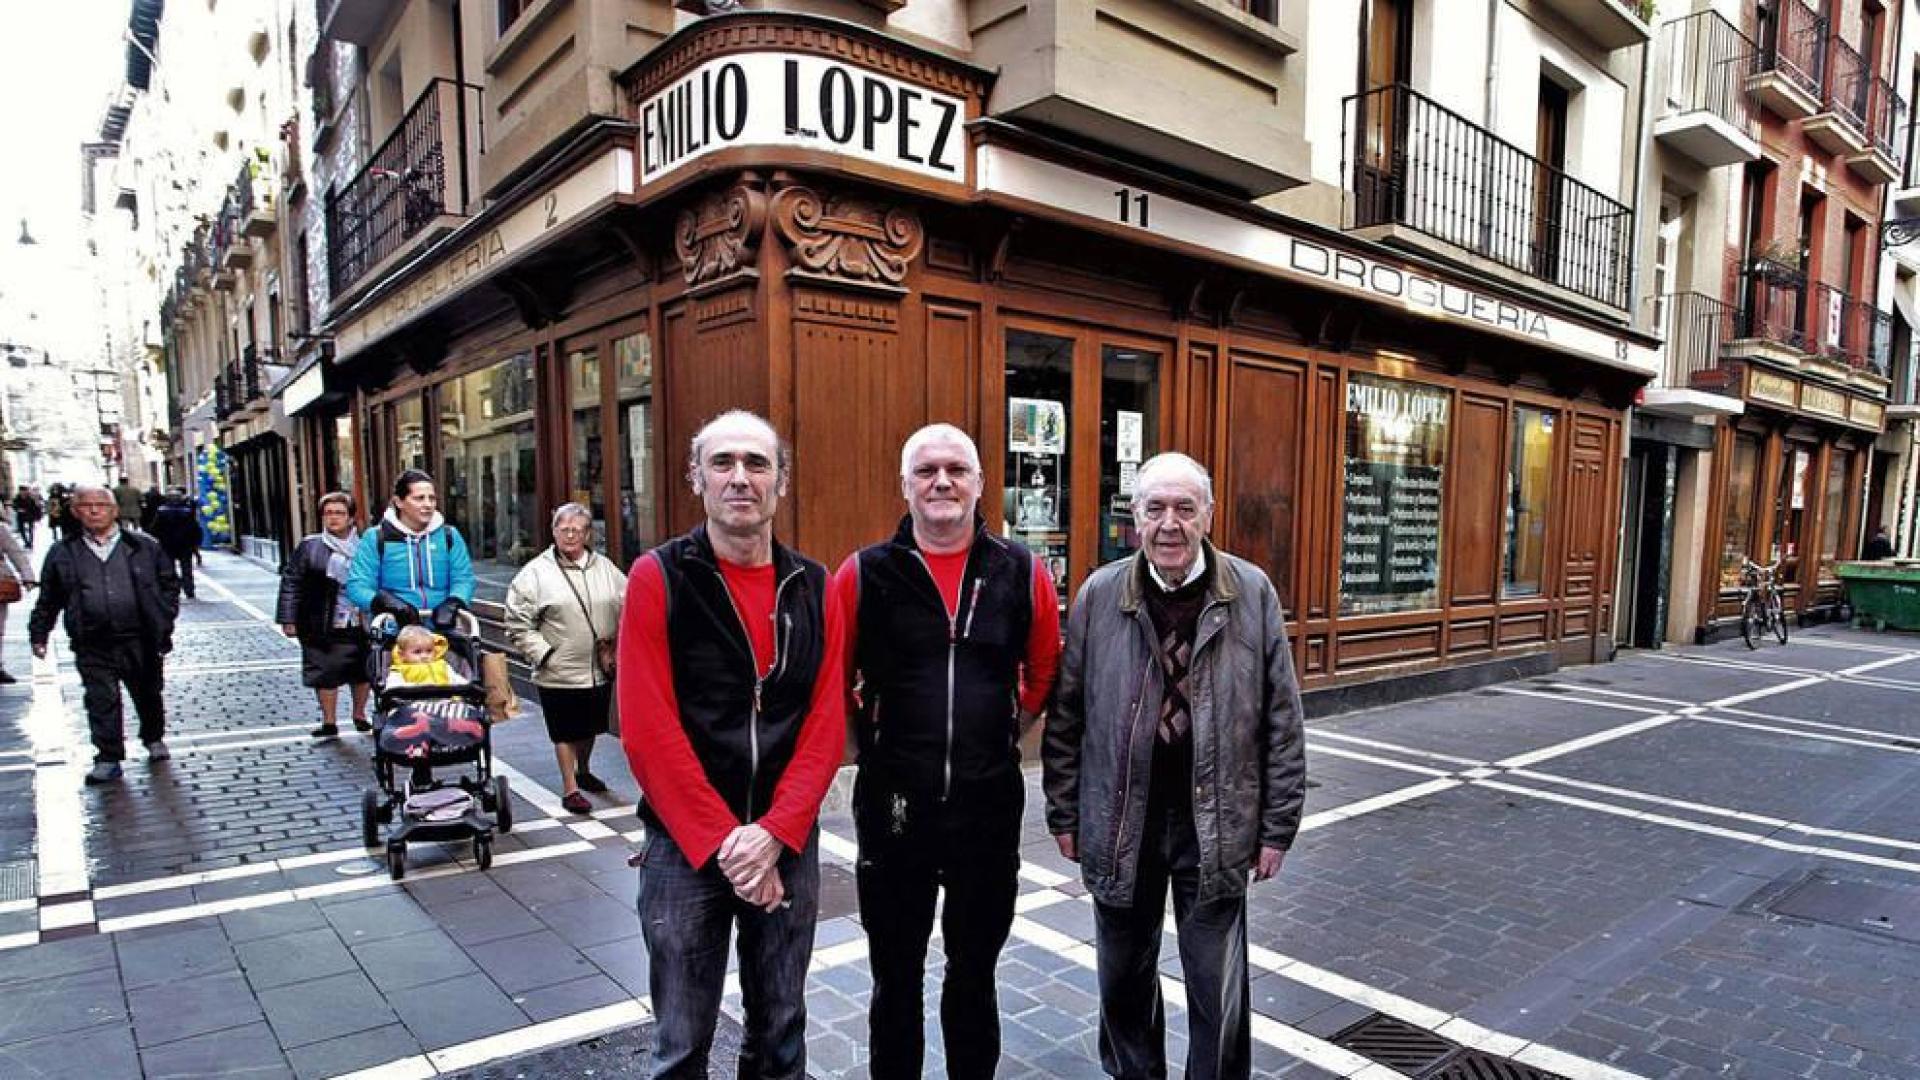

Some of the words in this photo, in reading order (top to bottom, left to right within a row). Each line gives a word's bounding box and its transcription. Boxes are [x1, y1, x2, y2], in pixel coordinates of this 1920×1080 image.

[642, 62, 749, 176] EMILIO
[783, 59, 959, 173] LOPEZ
[544, 190, 558, 230] 2
[1114, 188, 1150, 228] 11
[1290, 238, 1550, 340] DROGUERIA
[1345, 383, 1399, 420] EMILIO
